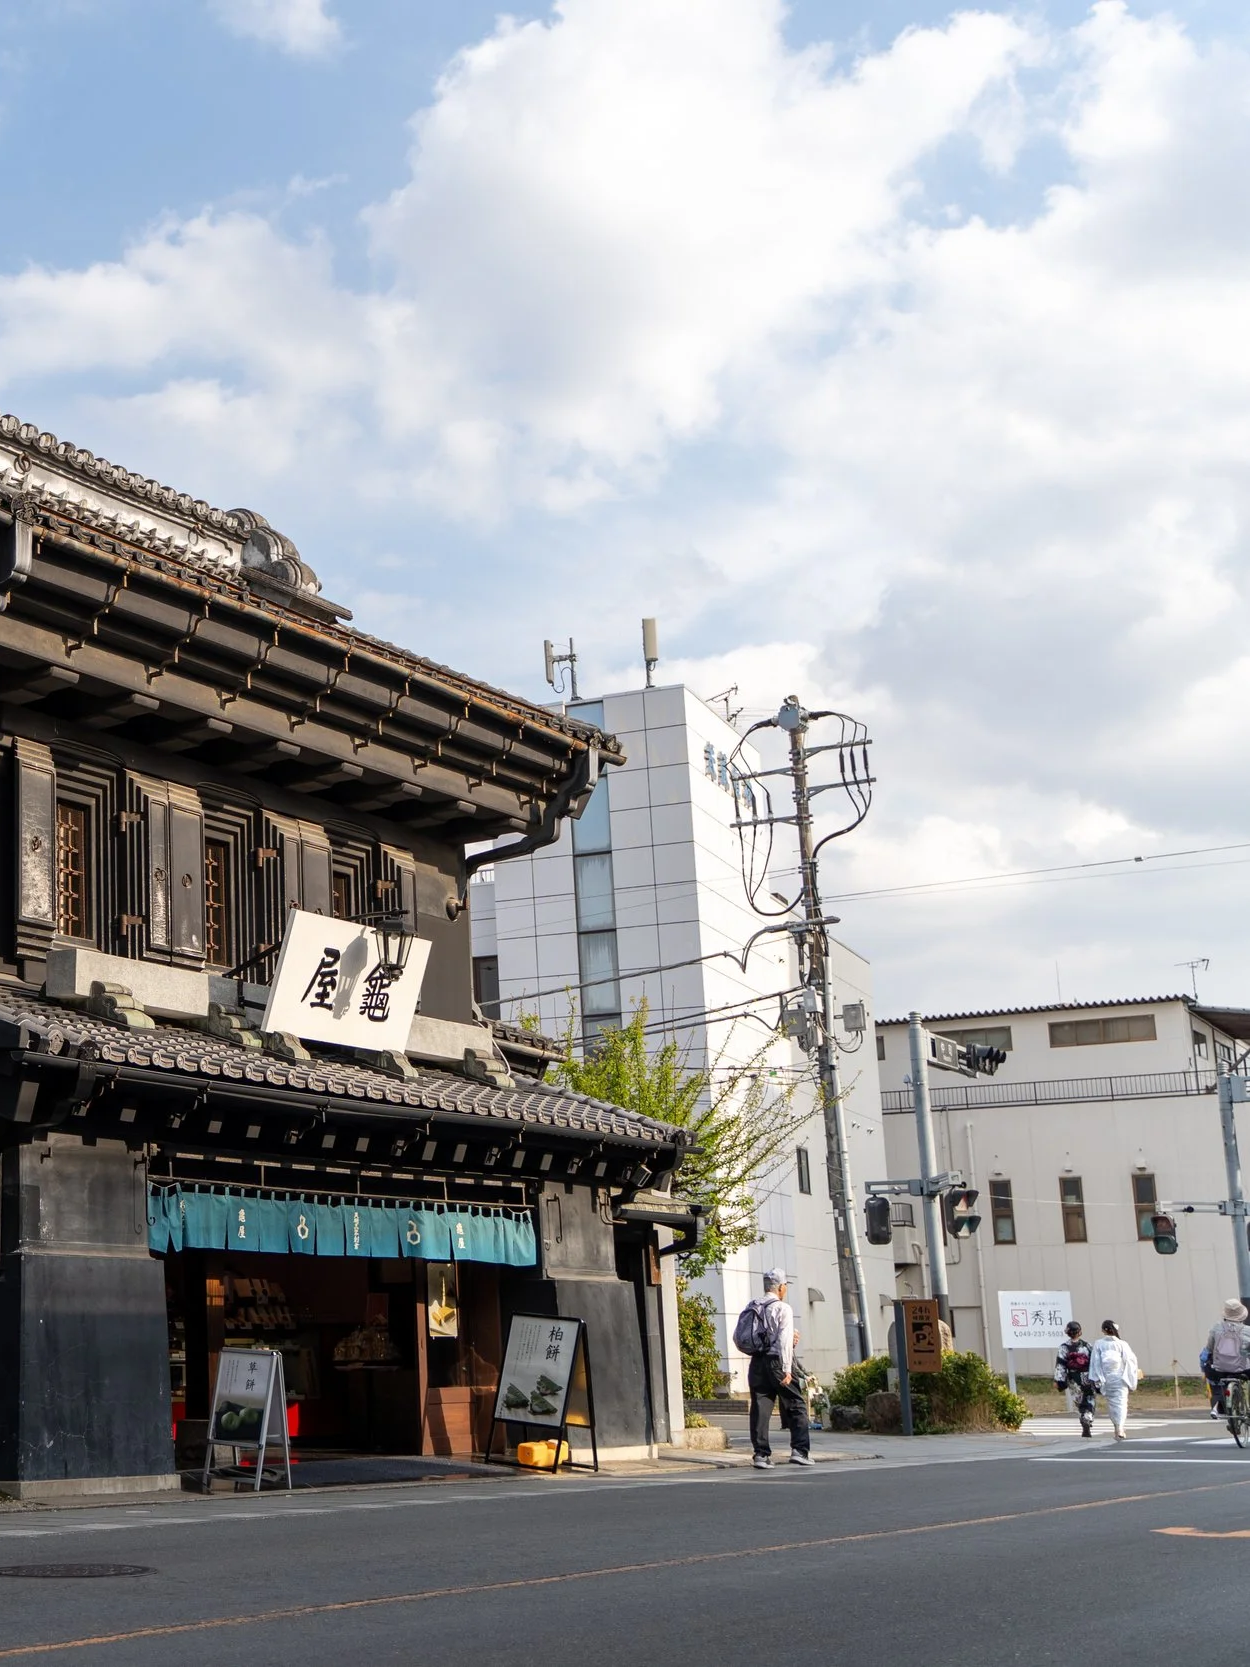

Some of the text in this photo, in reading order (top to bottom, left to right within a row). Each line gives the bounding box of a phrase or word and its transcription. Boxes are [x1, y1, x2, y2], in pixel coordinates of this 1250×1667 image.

[1031, 1310, 1063, 1325] 秀拓
[546, 1326, 563, 1361] 柏餅
[246, 1361, 258, 1391] 草餅
